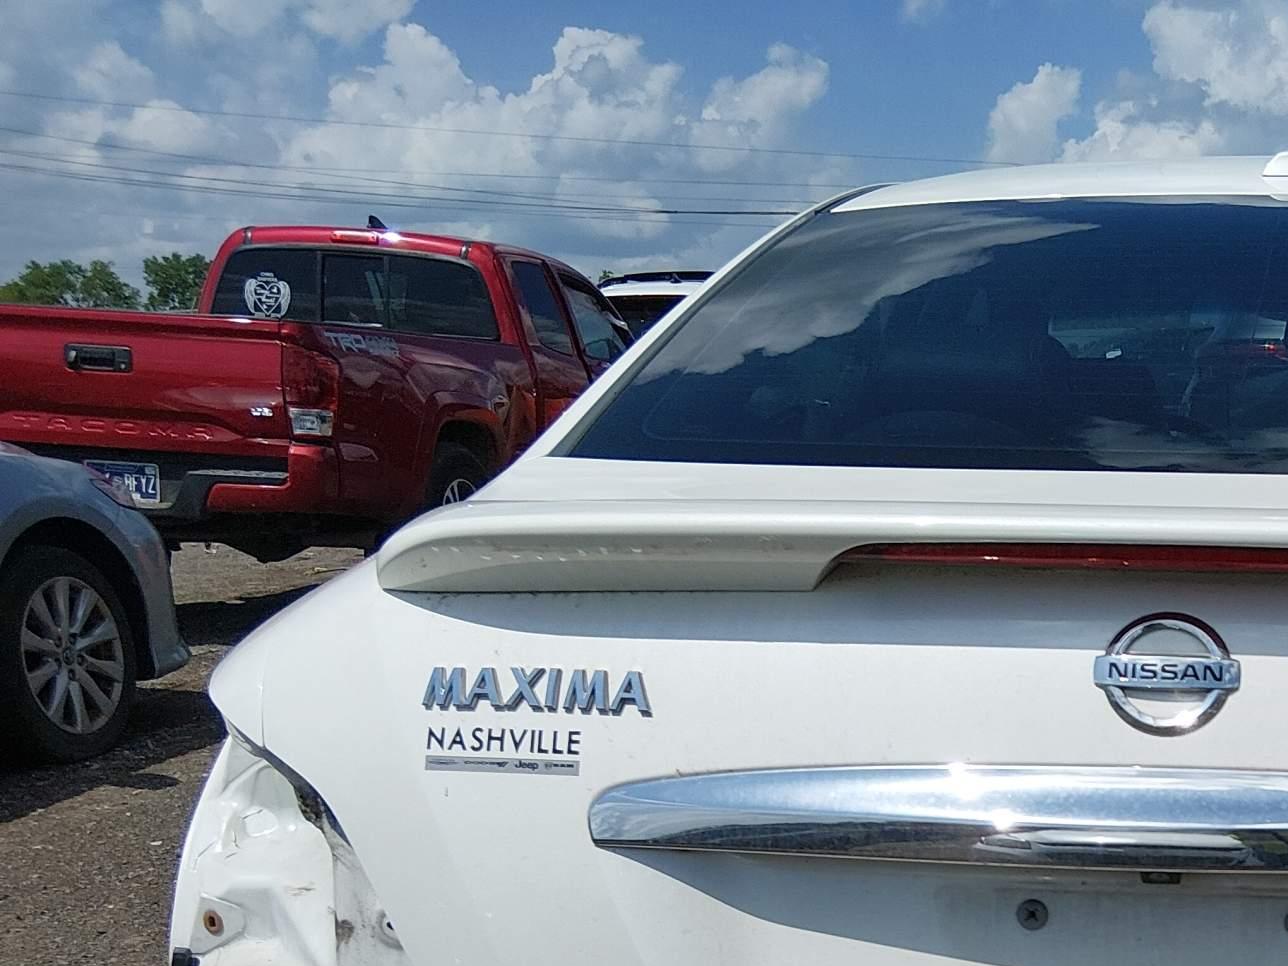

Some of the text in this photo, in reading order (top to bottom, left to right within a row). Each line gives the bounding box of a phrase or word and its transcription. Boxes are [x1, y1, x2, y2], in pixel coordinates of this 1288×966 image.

[12, 415, 214, 440] TACOMA
[1108, 662, 1224, 682] NISSAN
[422, 666, 653, 718] MAXIMA
[426, 726, 581, 755] NASHVILLE
[515, 760, 539, 771] Jeep
